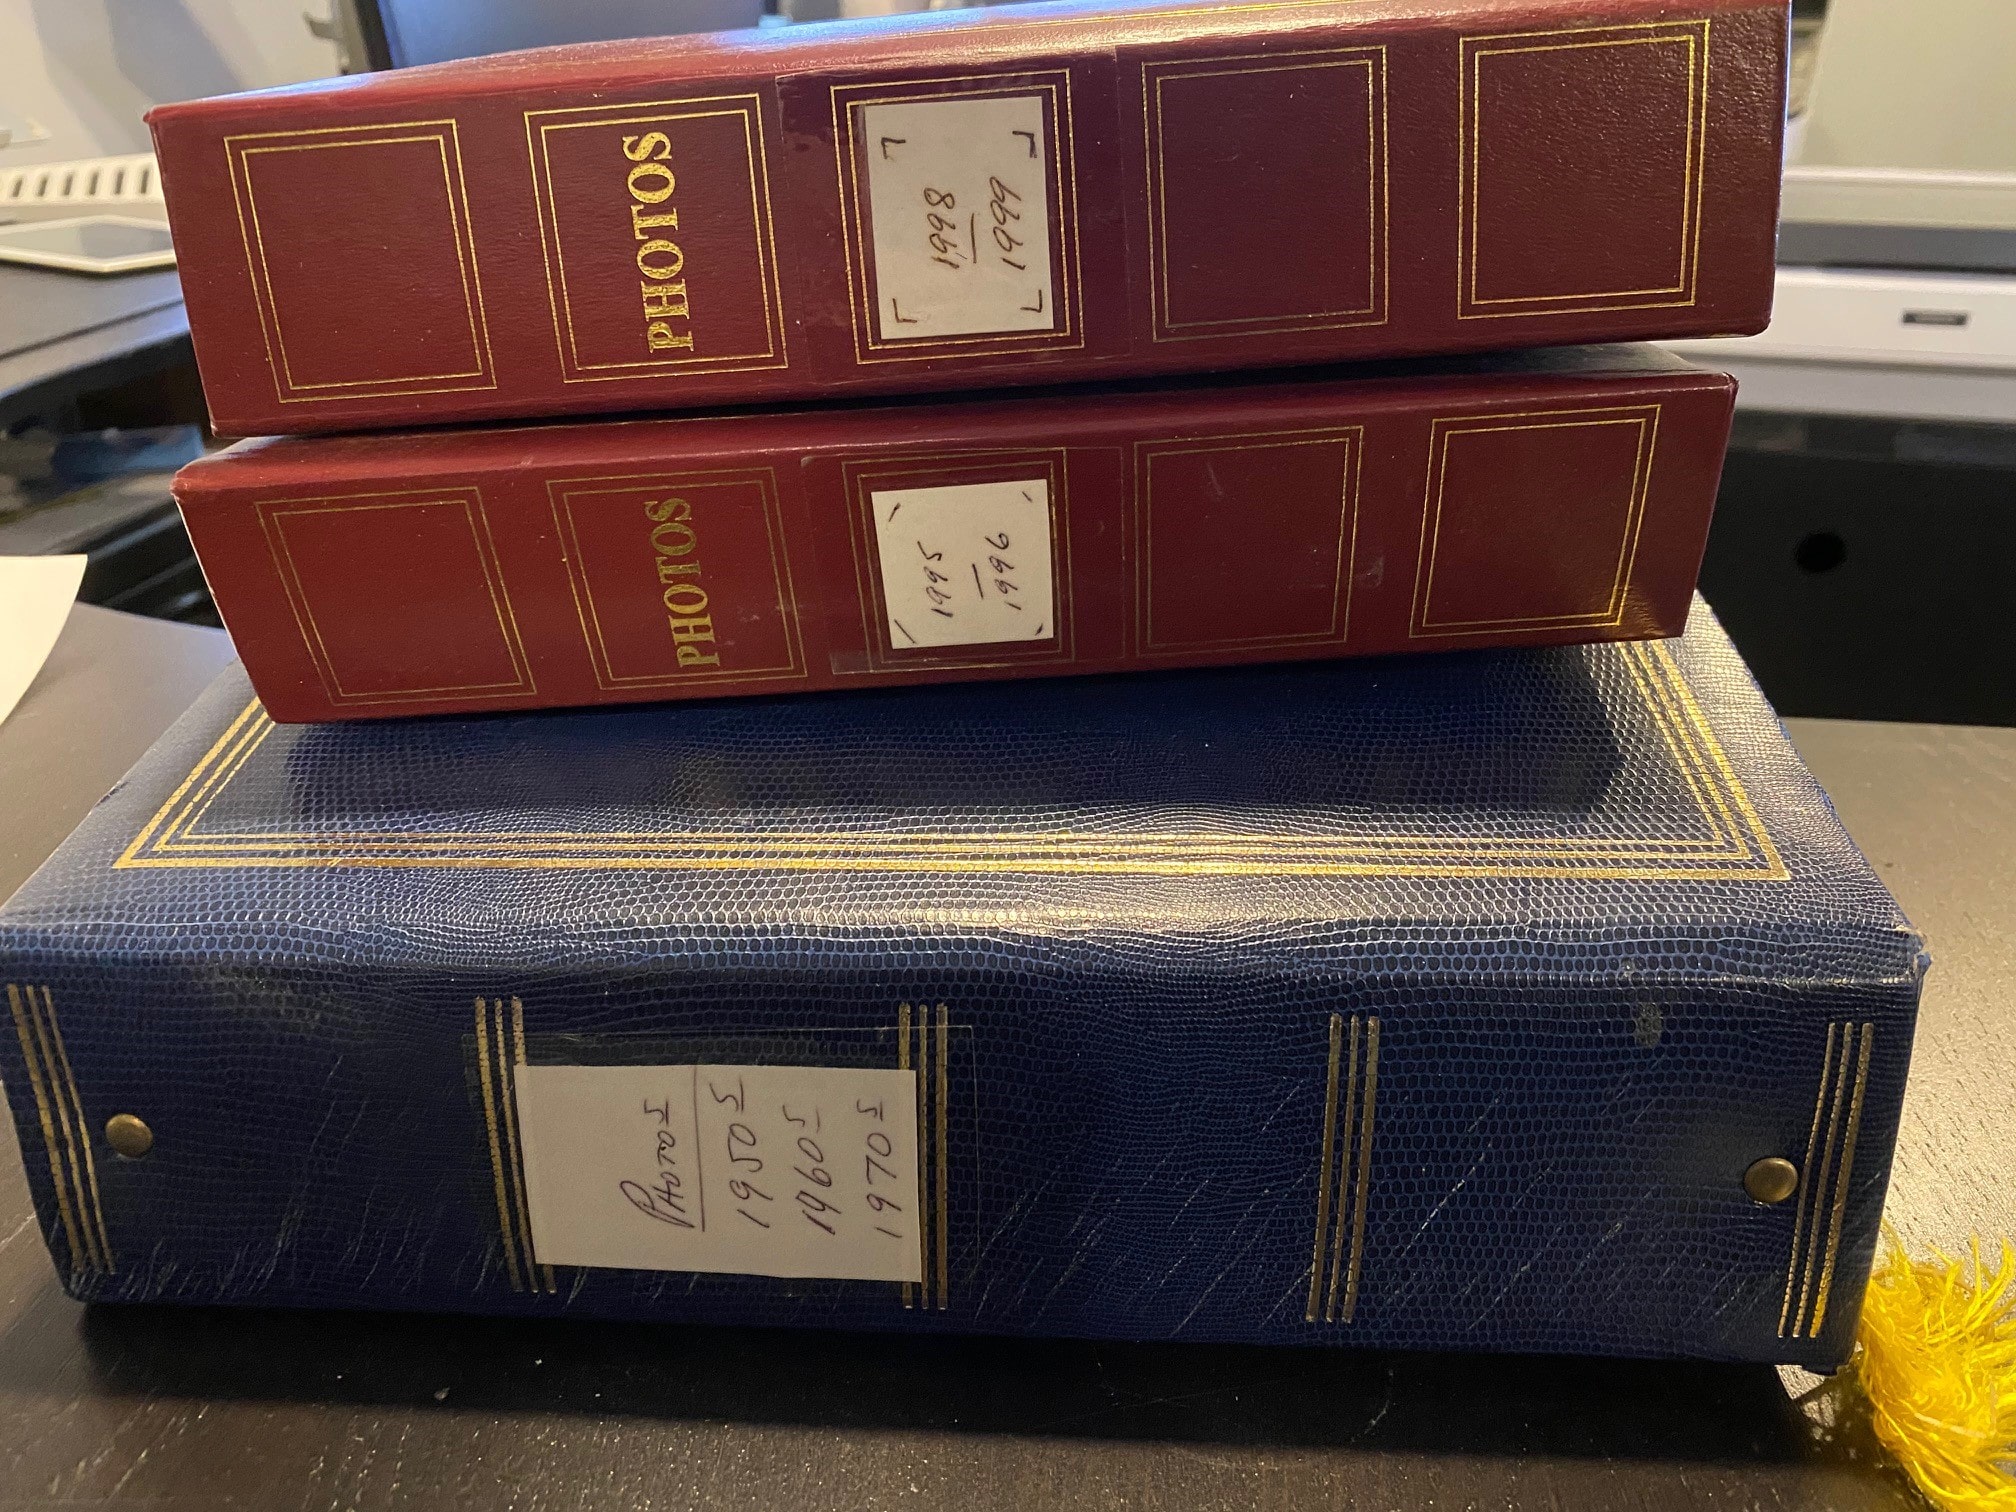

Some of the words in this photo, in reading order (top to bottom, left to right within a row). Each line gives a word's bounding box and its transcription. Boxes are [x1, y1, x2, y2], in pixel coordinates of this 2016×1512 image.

[622, 131, 694, 353] PHOTOS
[924, 187, 961, 269] 1998
[989, 176, 1027, 271] 1999
[644, 497, 721, 668] PHOTOS
[916, 540, 954, 618] 1995
[984, 532, 1022, 611] 1996
